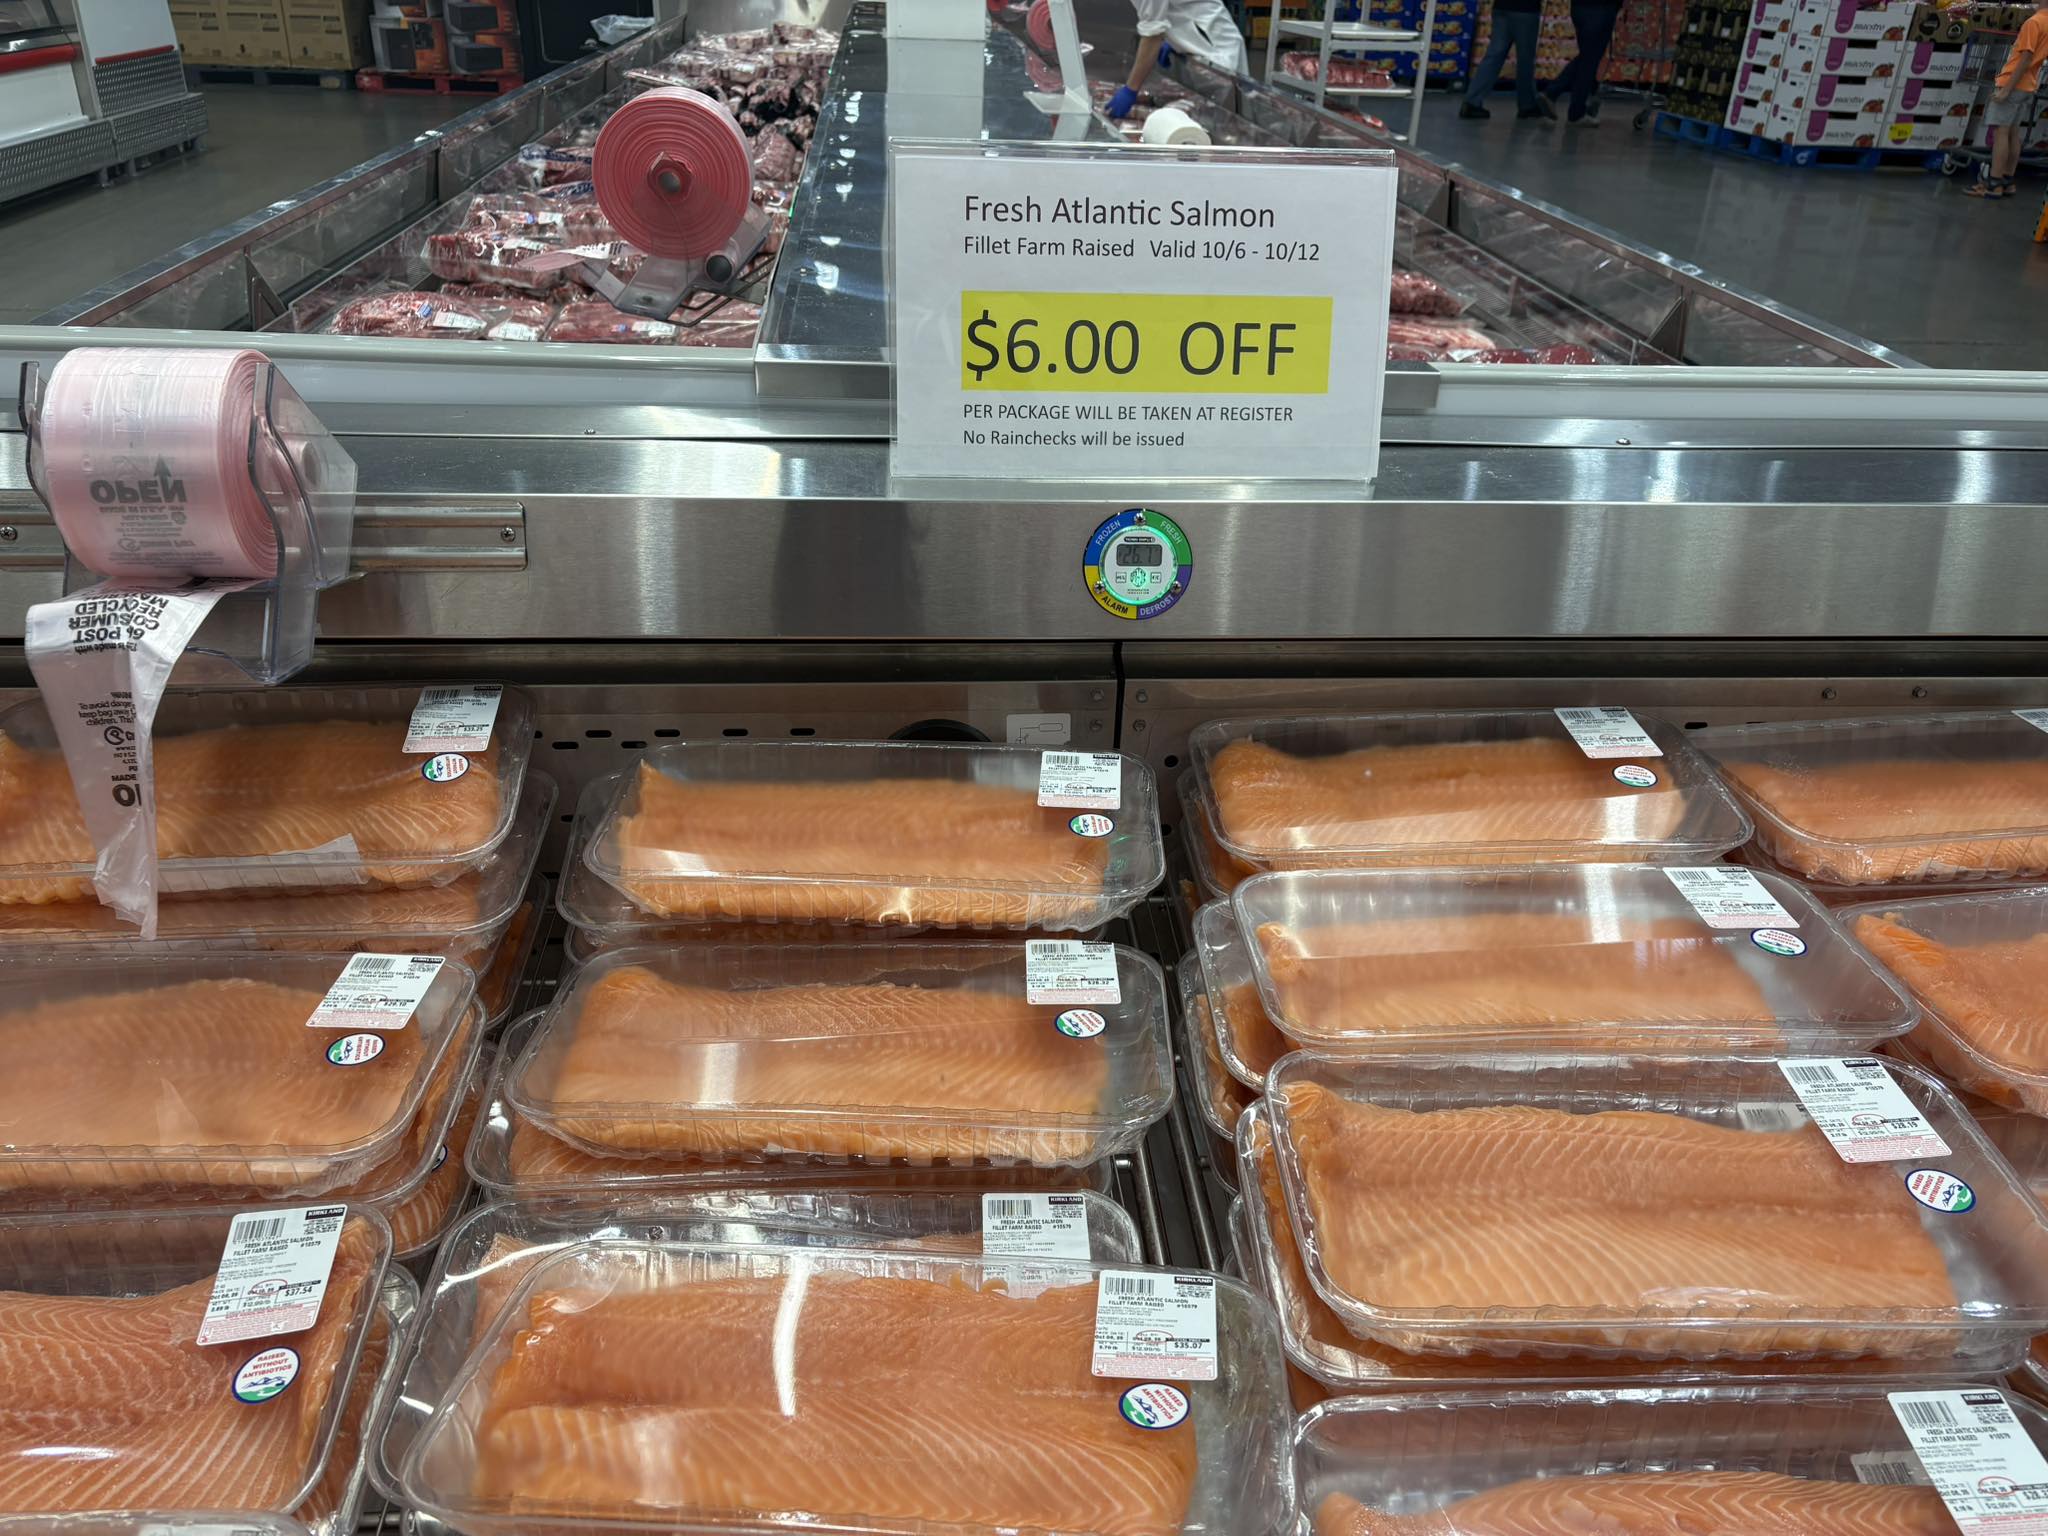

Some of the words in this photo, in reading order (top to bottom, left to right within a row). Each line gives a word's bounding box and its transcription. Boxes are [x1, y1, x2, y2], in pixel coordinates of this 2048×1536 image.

[965, 195, 1042, 223] Fresh
[1051, 196, 1161, 225] Atlantic
[1170, 199, 1275, 228] Salmon
[964, 235, 1011, 255] Fillet
[1017, 237, 1065, 256] Farm
[1072, 238, 1135, 257] Raised
[1149, 239, 1196, 258] Valid
[1202, 239, 1246, 262] 10/6
[1265, 241, 1320, 263] 10/12
[966, 309, 1140, 381] $6.00
[1179, 321, 1297, 376] OFF
[963, 404, 993, 420] PER
[998, 404, 1071, 421] PACKAGE
[1075, 405, 1113, 421] WILL
[1118, 405, 1137, 421] BE
[1141, 406, 1192, 421] TAKEN
[1196, 406, 1216, 421] AT
[1219, 406, 1294, 422] REGISTER
[963, 430, 986, 446] No
[990, 430, 1077, 446] Rainchecks
[1081, 431, 1108, 446] will
[1112, 431, 1131, 446] be
[1136, 431, 1185, 447] issued
[1095, 520, 1121, 545] FROZEN
[1160, 520, 1182, 544] FRESH
[1102, 595, 1129, 614] ALARM
[1139, 595, 1174, 616] DEFROST
[73, 627, 122, 644] POST
[308, 1208, 343, 1217] KIRKLAND
[285, 1286, 312, 1297] $37.54
[253, 1358, 289, 1370] WITHOUT
[257, 1352, 286, 1362] RAISED
[242, 1364, 292, 1379] ANTIBIOTICS
[1154, 1389, 1179, 1412] WITHOUT
[1164, 1388, 1184, 1407] RAISED
